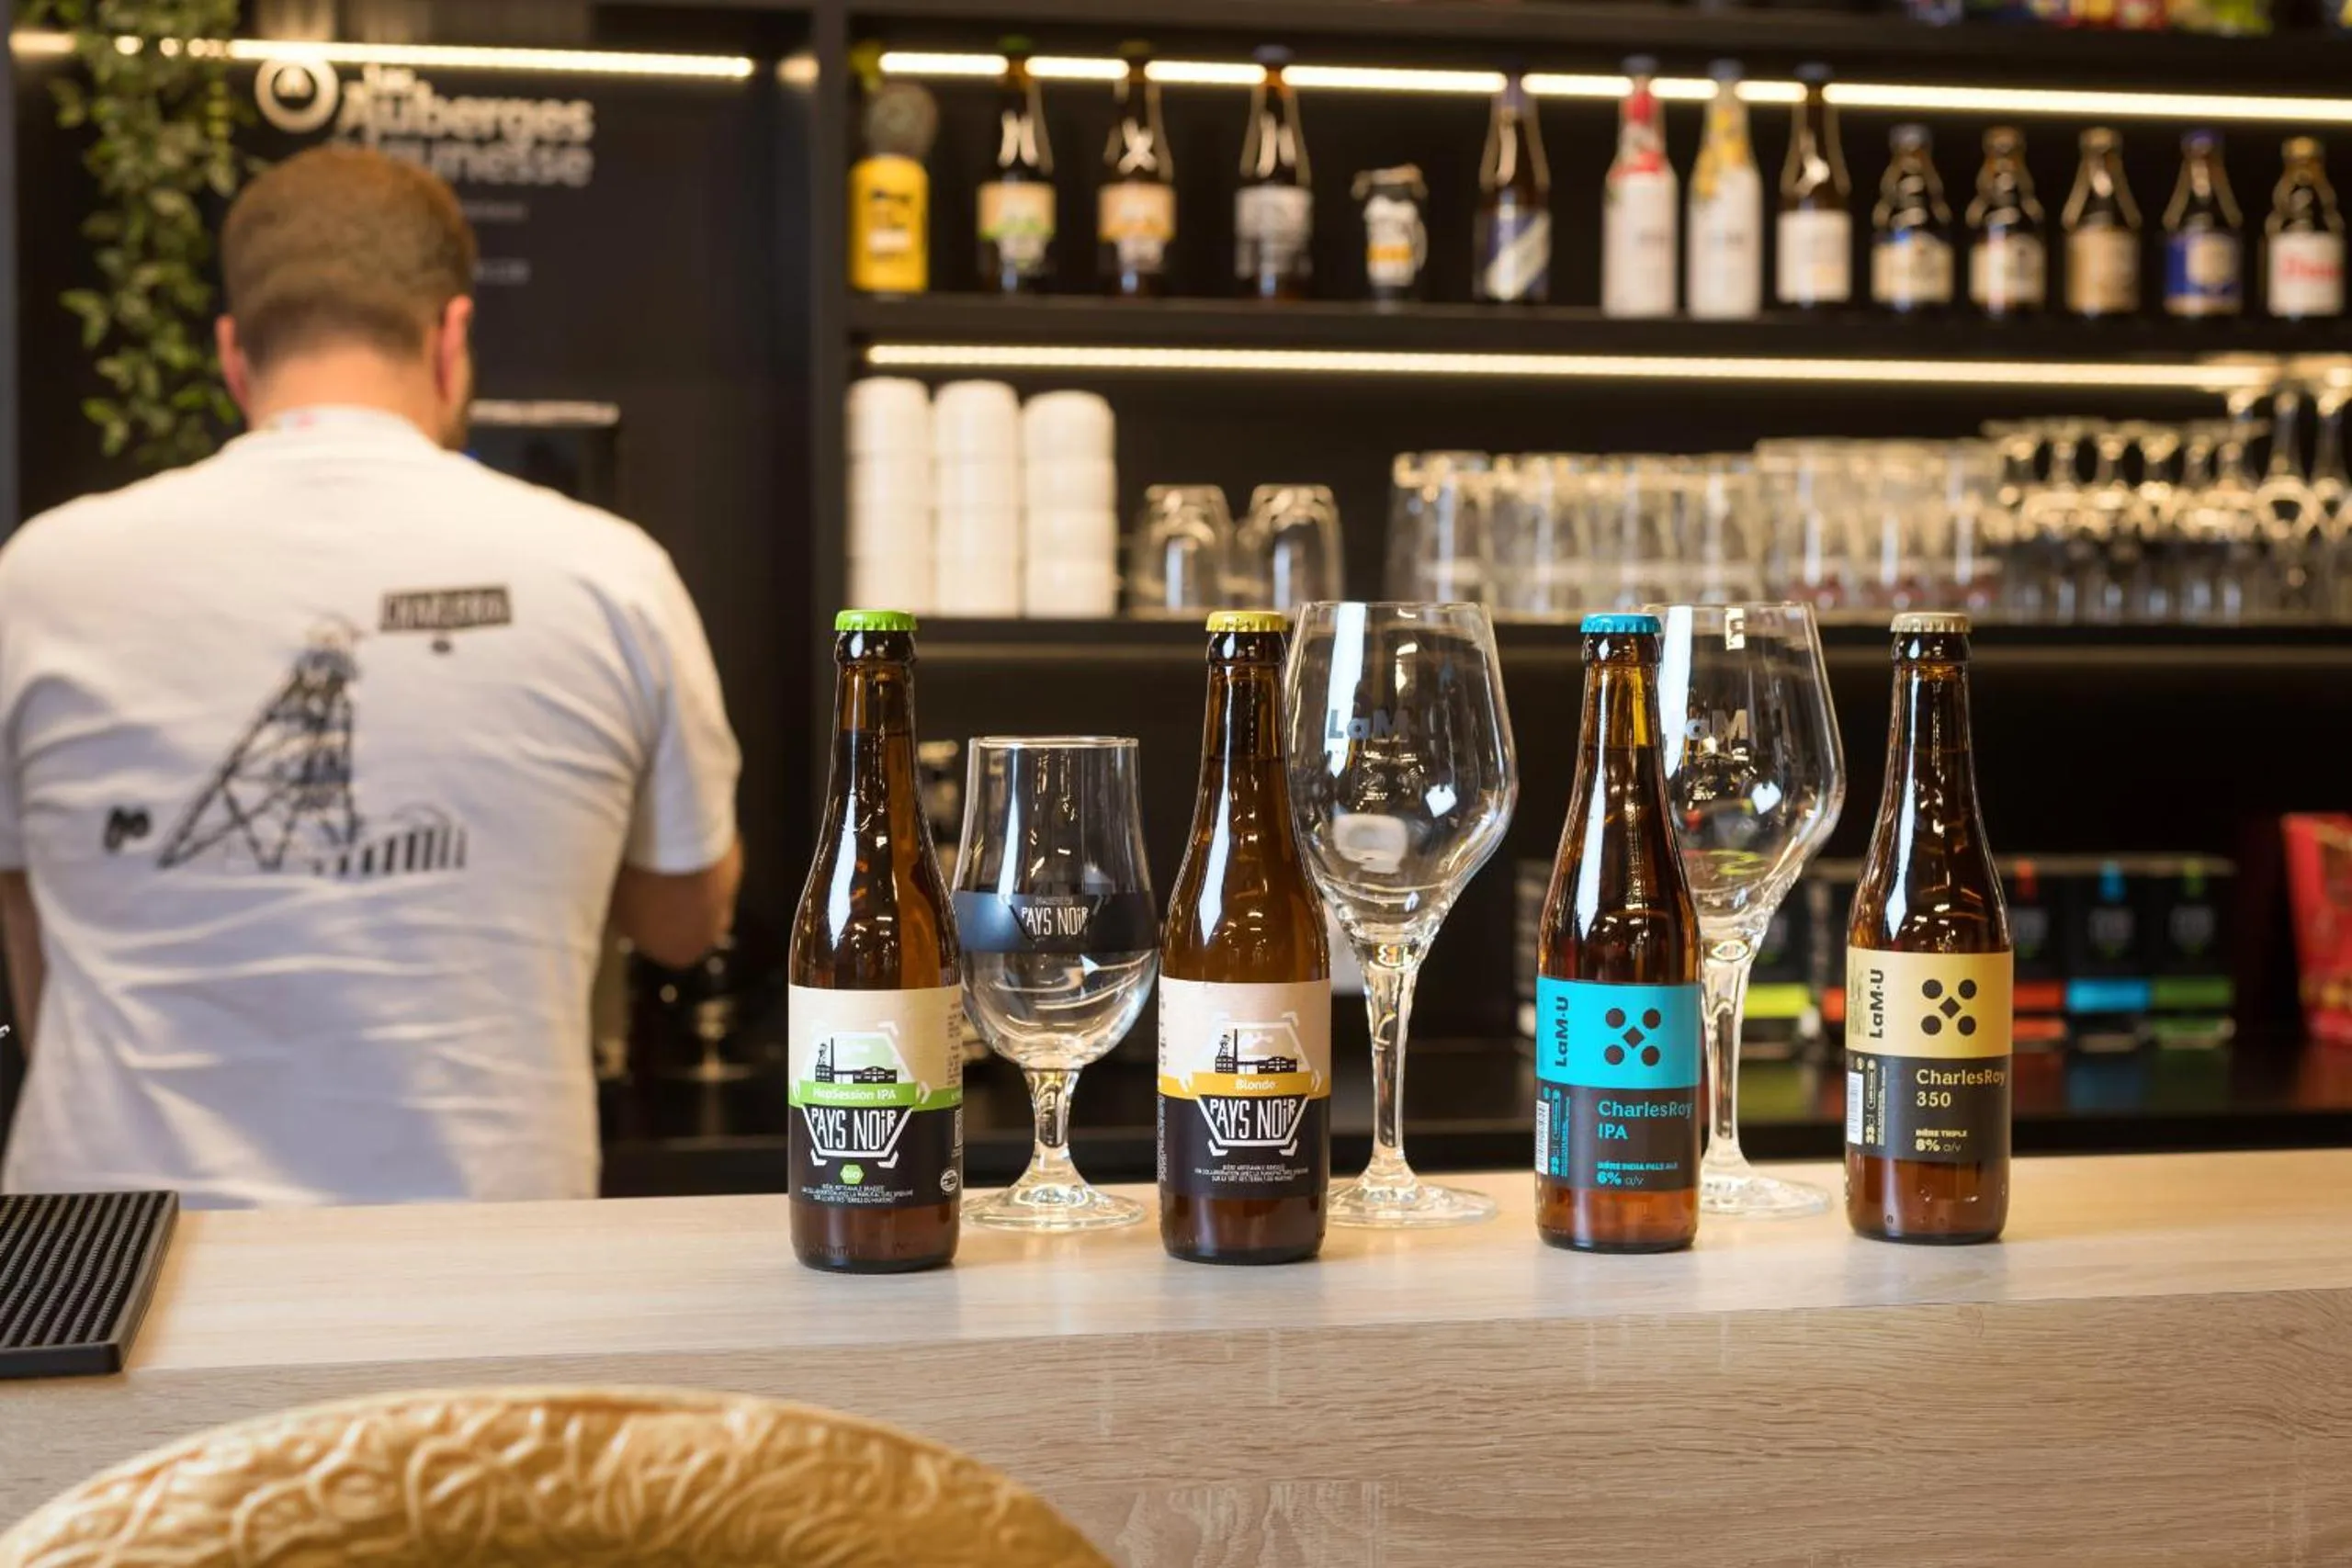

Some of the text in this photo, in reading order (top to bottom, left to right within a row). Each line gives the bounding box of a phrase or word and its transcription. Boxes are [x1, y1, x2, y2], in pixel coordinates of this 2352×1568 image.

[1022, 907, 1052, 935] PAYS
[1235, 1078, 1276, 1091] Blonde
[876, 1089, 897, 1100] IPA
[1916, 1091, 1951, 1108] 350
[1209, 1098, 1250, 1139] PAYS
[811, 1108, 846, 1149] PAYS
[1598, 1123, 1629, 1140] IPA
[1597, 1171, 1623, 1186] 6%
